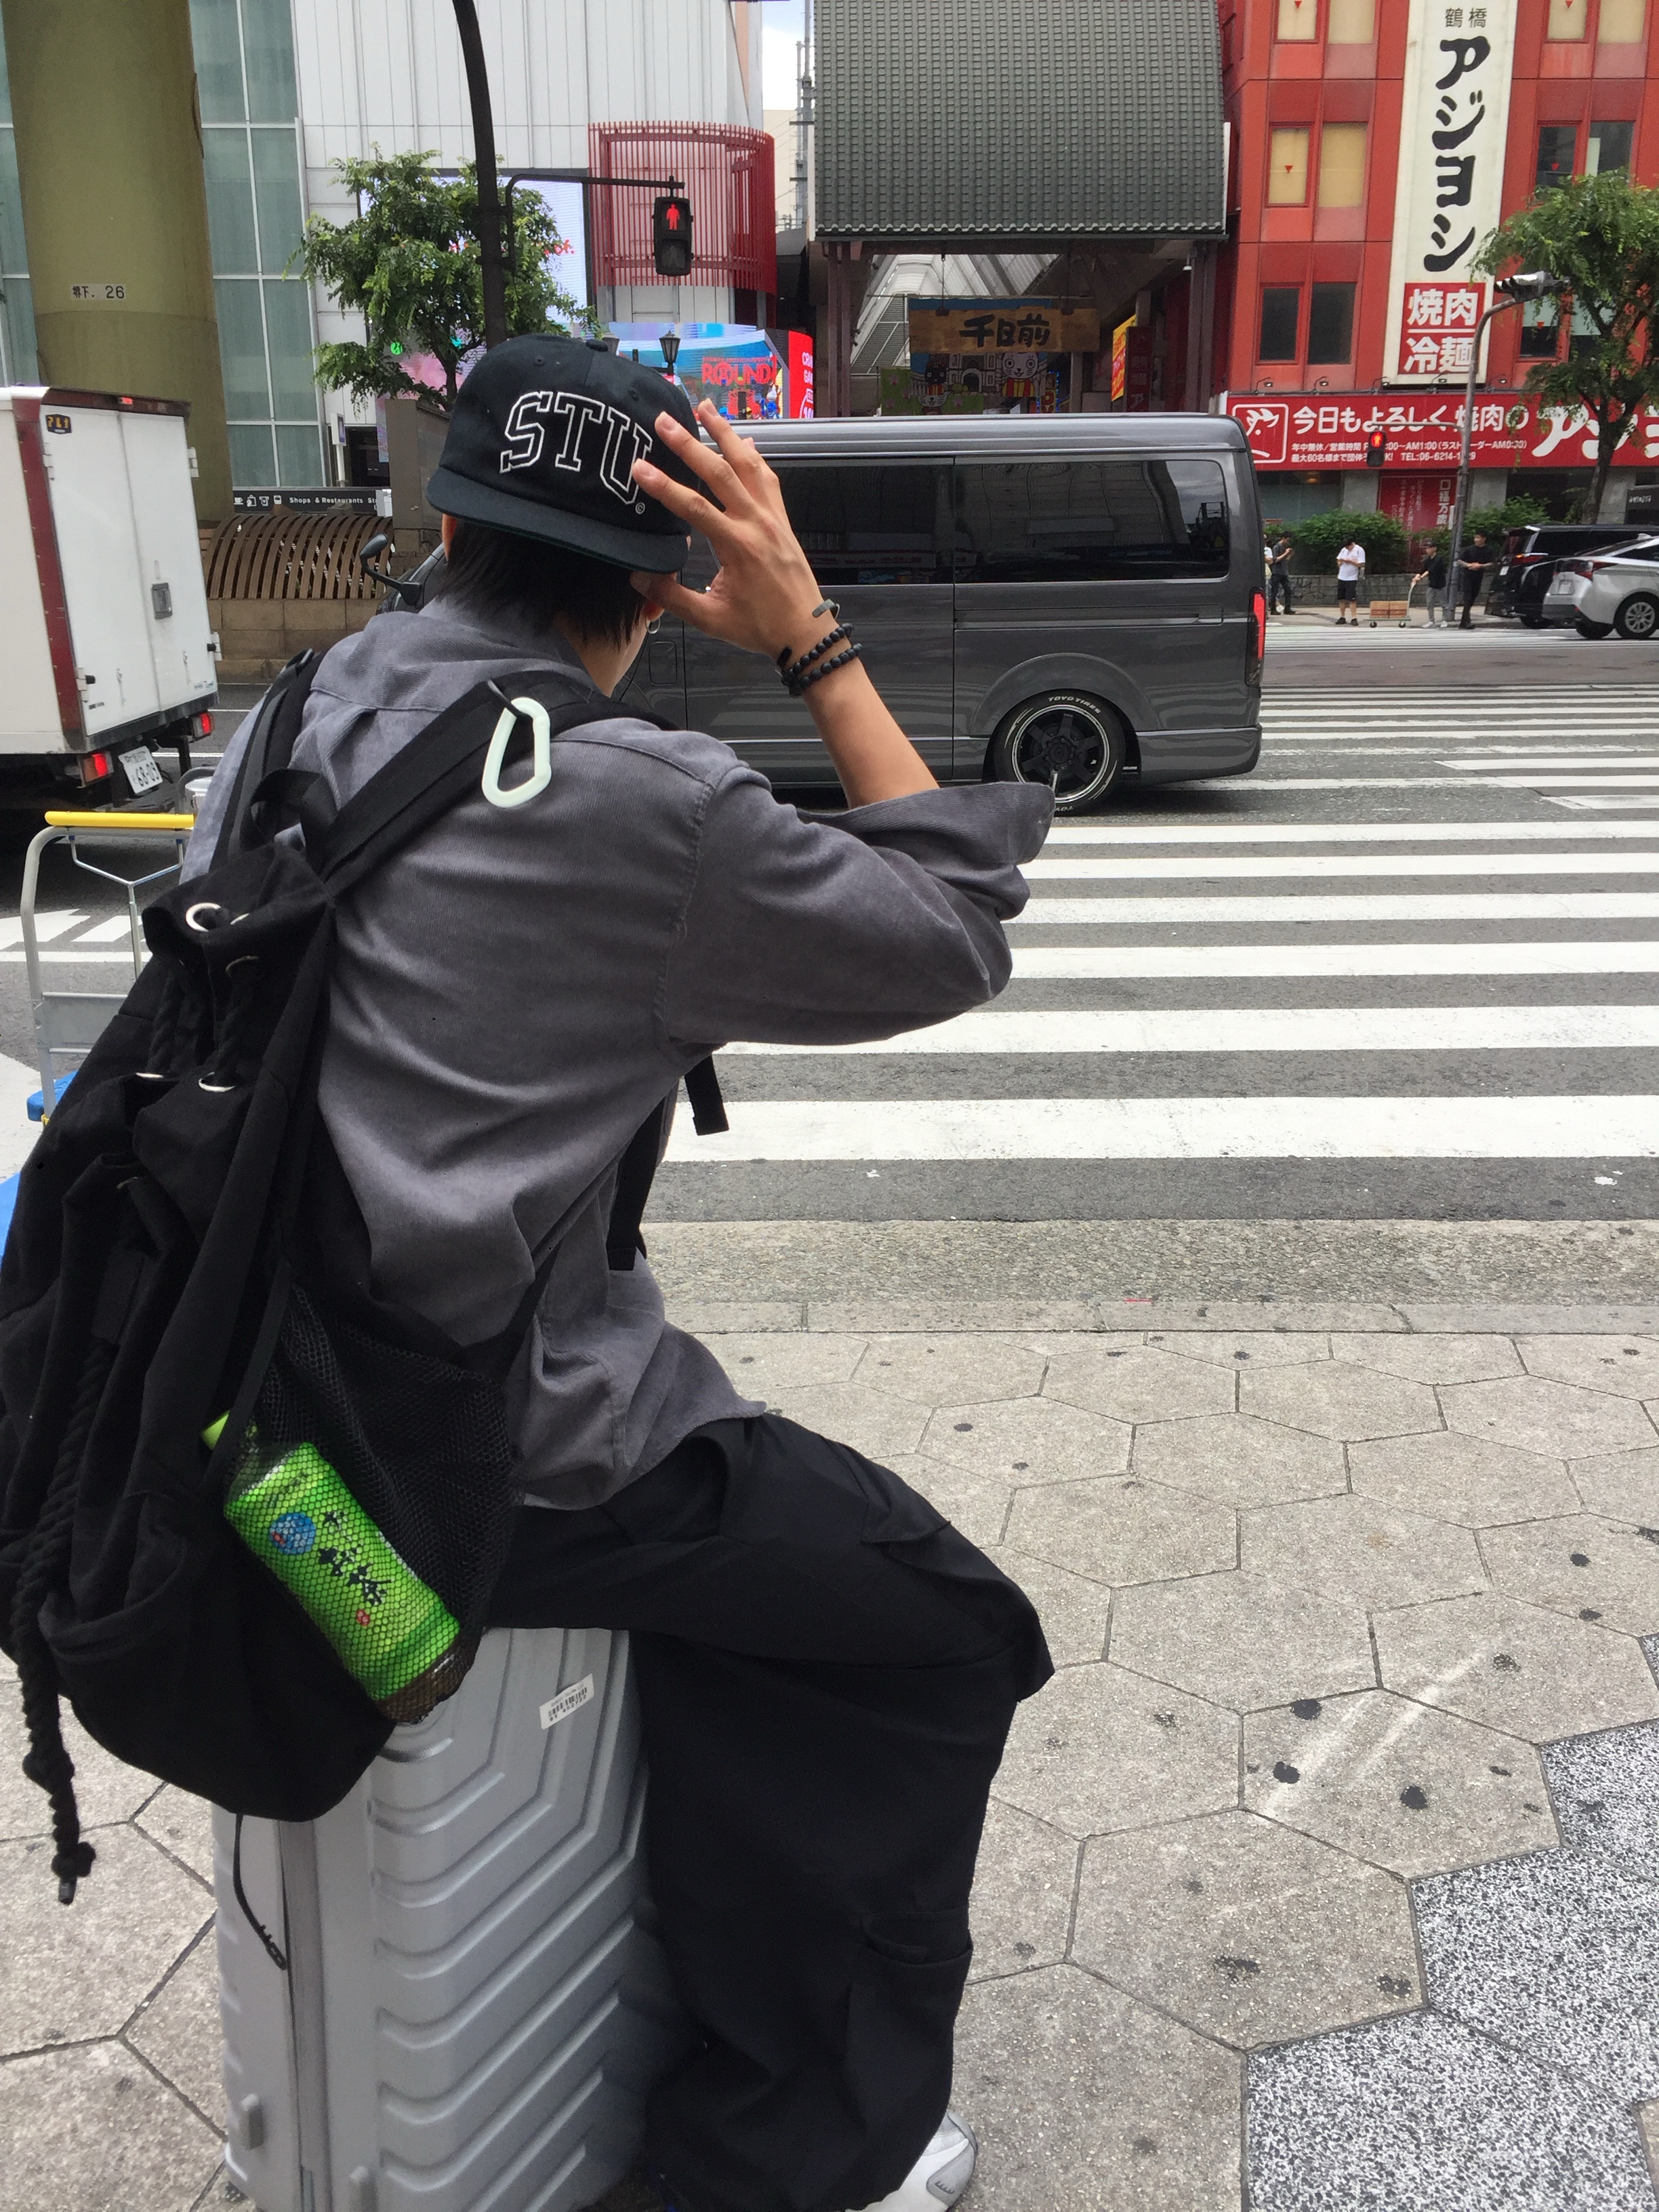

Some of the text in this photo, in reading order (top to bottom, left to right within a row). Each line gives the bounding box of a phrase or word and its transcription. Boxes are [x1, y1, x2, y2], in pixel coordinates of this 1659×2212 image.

[1445, 7, 1487, 28] 鶴橋
[105, 285, 125, 299] 26
[1406, 289, 1478, 326] 焼肉
[959, 313, 1050, 348] 千日前
[1403, 336, 1475, 373] 冷麺
[1293, 405, 1447, 434] 今日もよろしく
[499, 390, 653, 505] STU
[1076, 697, 1101, 714] TIRES
